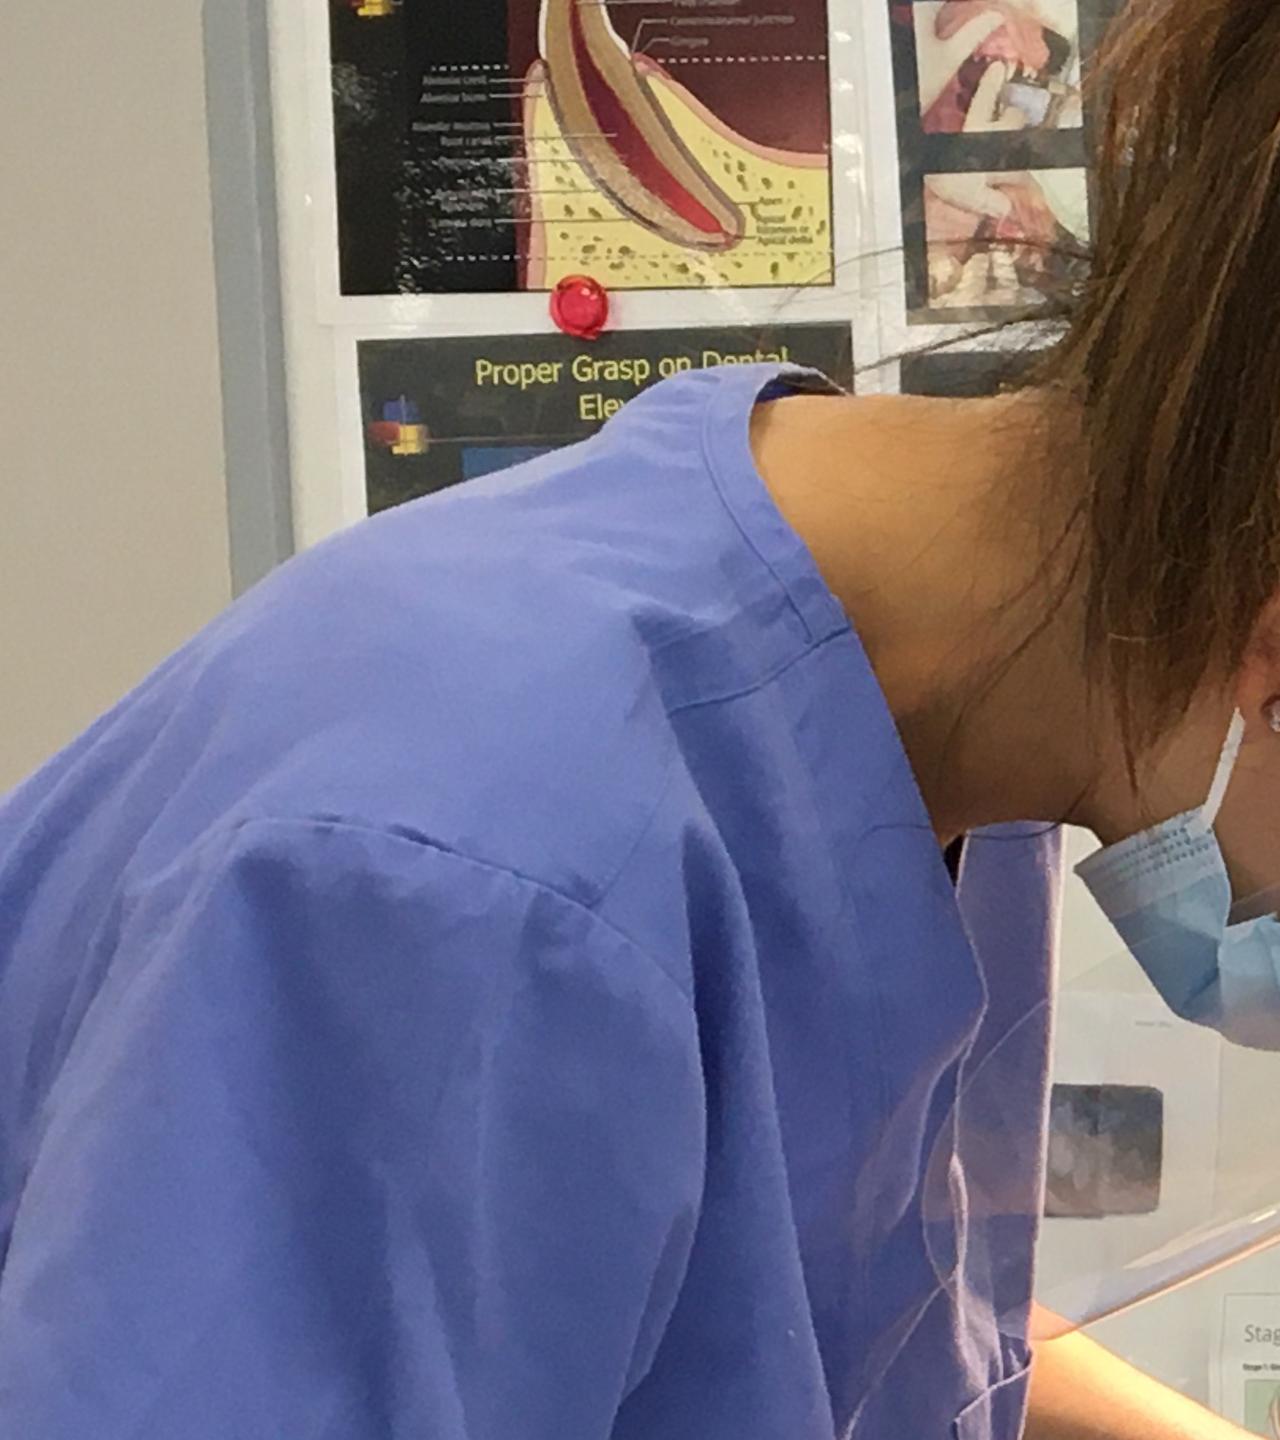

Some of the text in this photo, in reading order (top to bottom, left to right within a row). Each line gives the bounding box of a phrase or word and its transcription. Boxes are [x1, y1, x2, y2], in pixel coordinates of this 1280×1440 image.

[475, 358, 562, 390] Proper
[572, 354, 650, 385] Grasp
[658, 355, 691, 378] on
